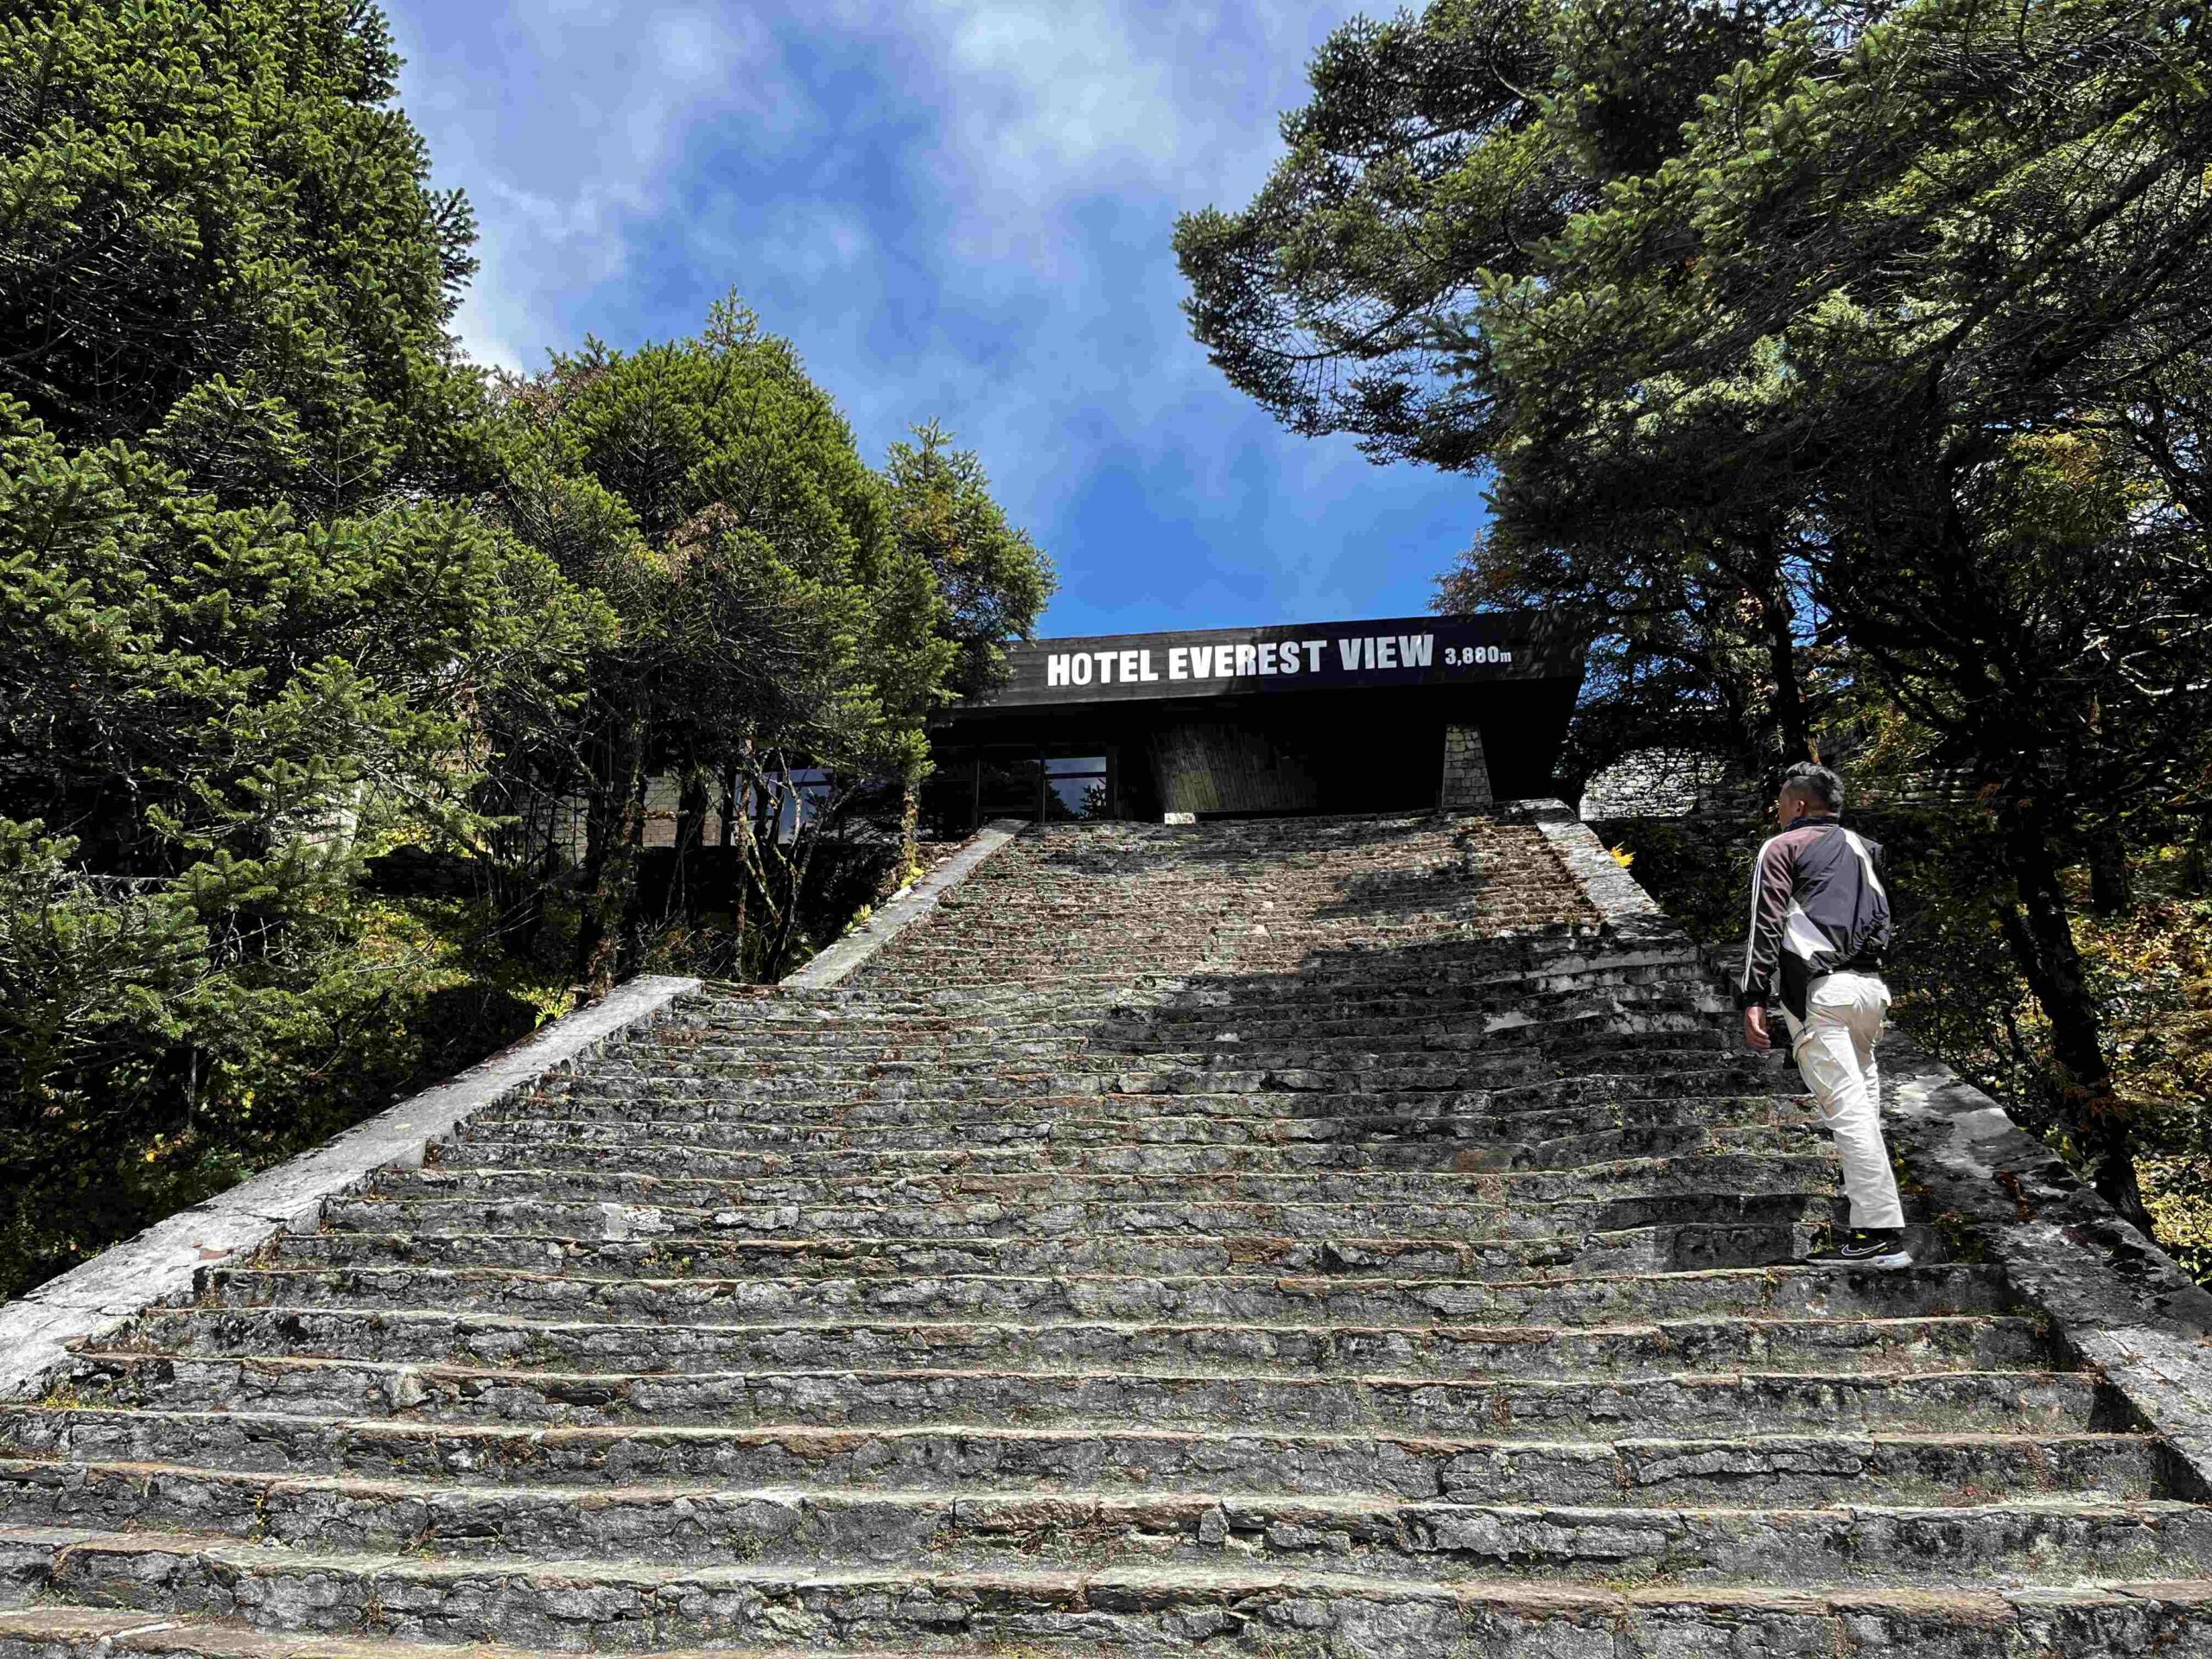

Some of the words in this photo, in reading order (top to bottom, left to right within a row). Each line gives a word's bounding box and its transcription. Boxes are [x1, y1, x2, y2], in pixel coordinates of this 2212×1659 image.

[1046, 649, 1160, 687] HOTEL
[1168, 639, 1327, 681] EVEREST
[1338, 633, 1435, 671] VIEW
[1445, 645, 1512, 666] 3,880m
